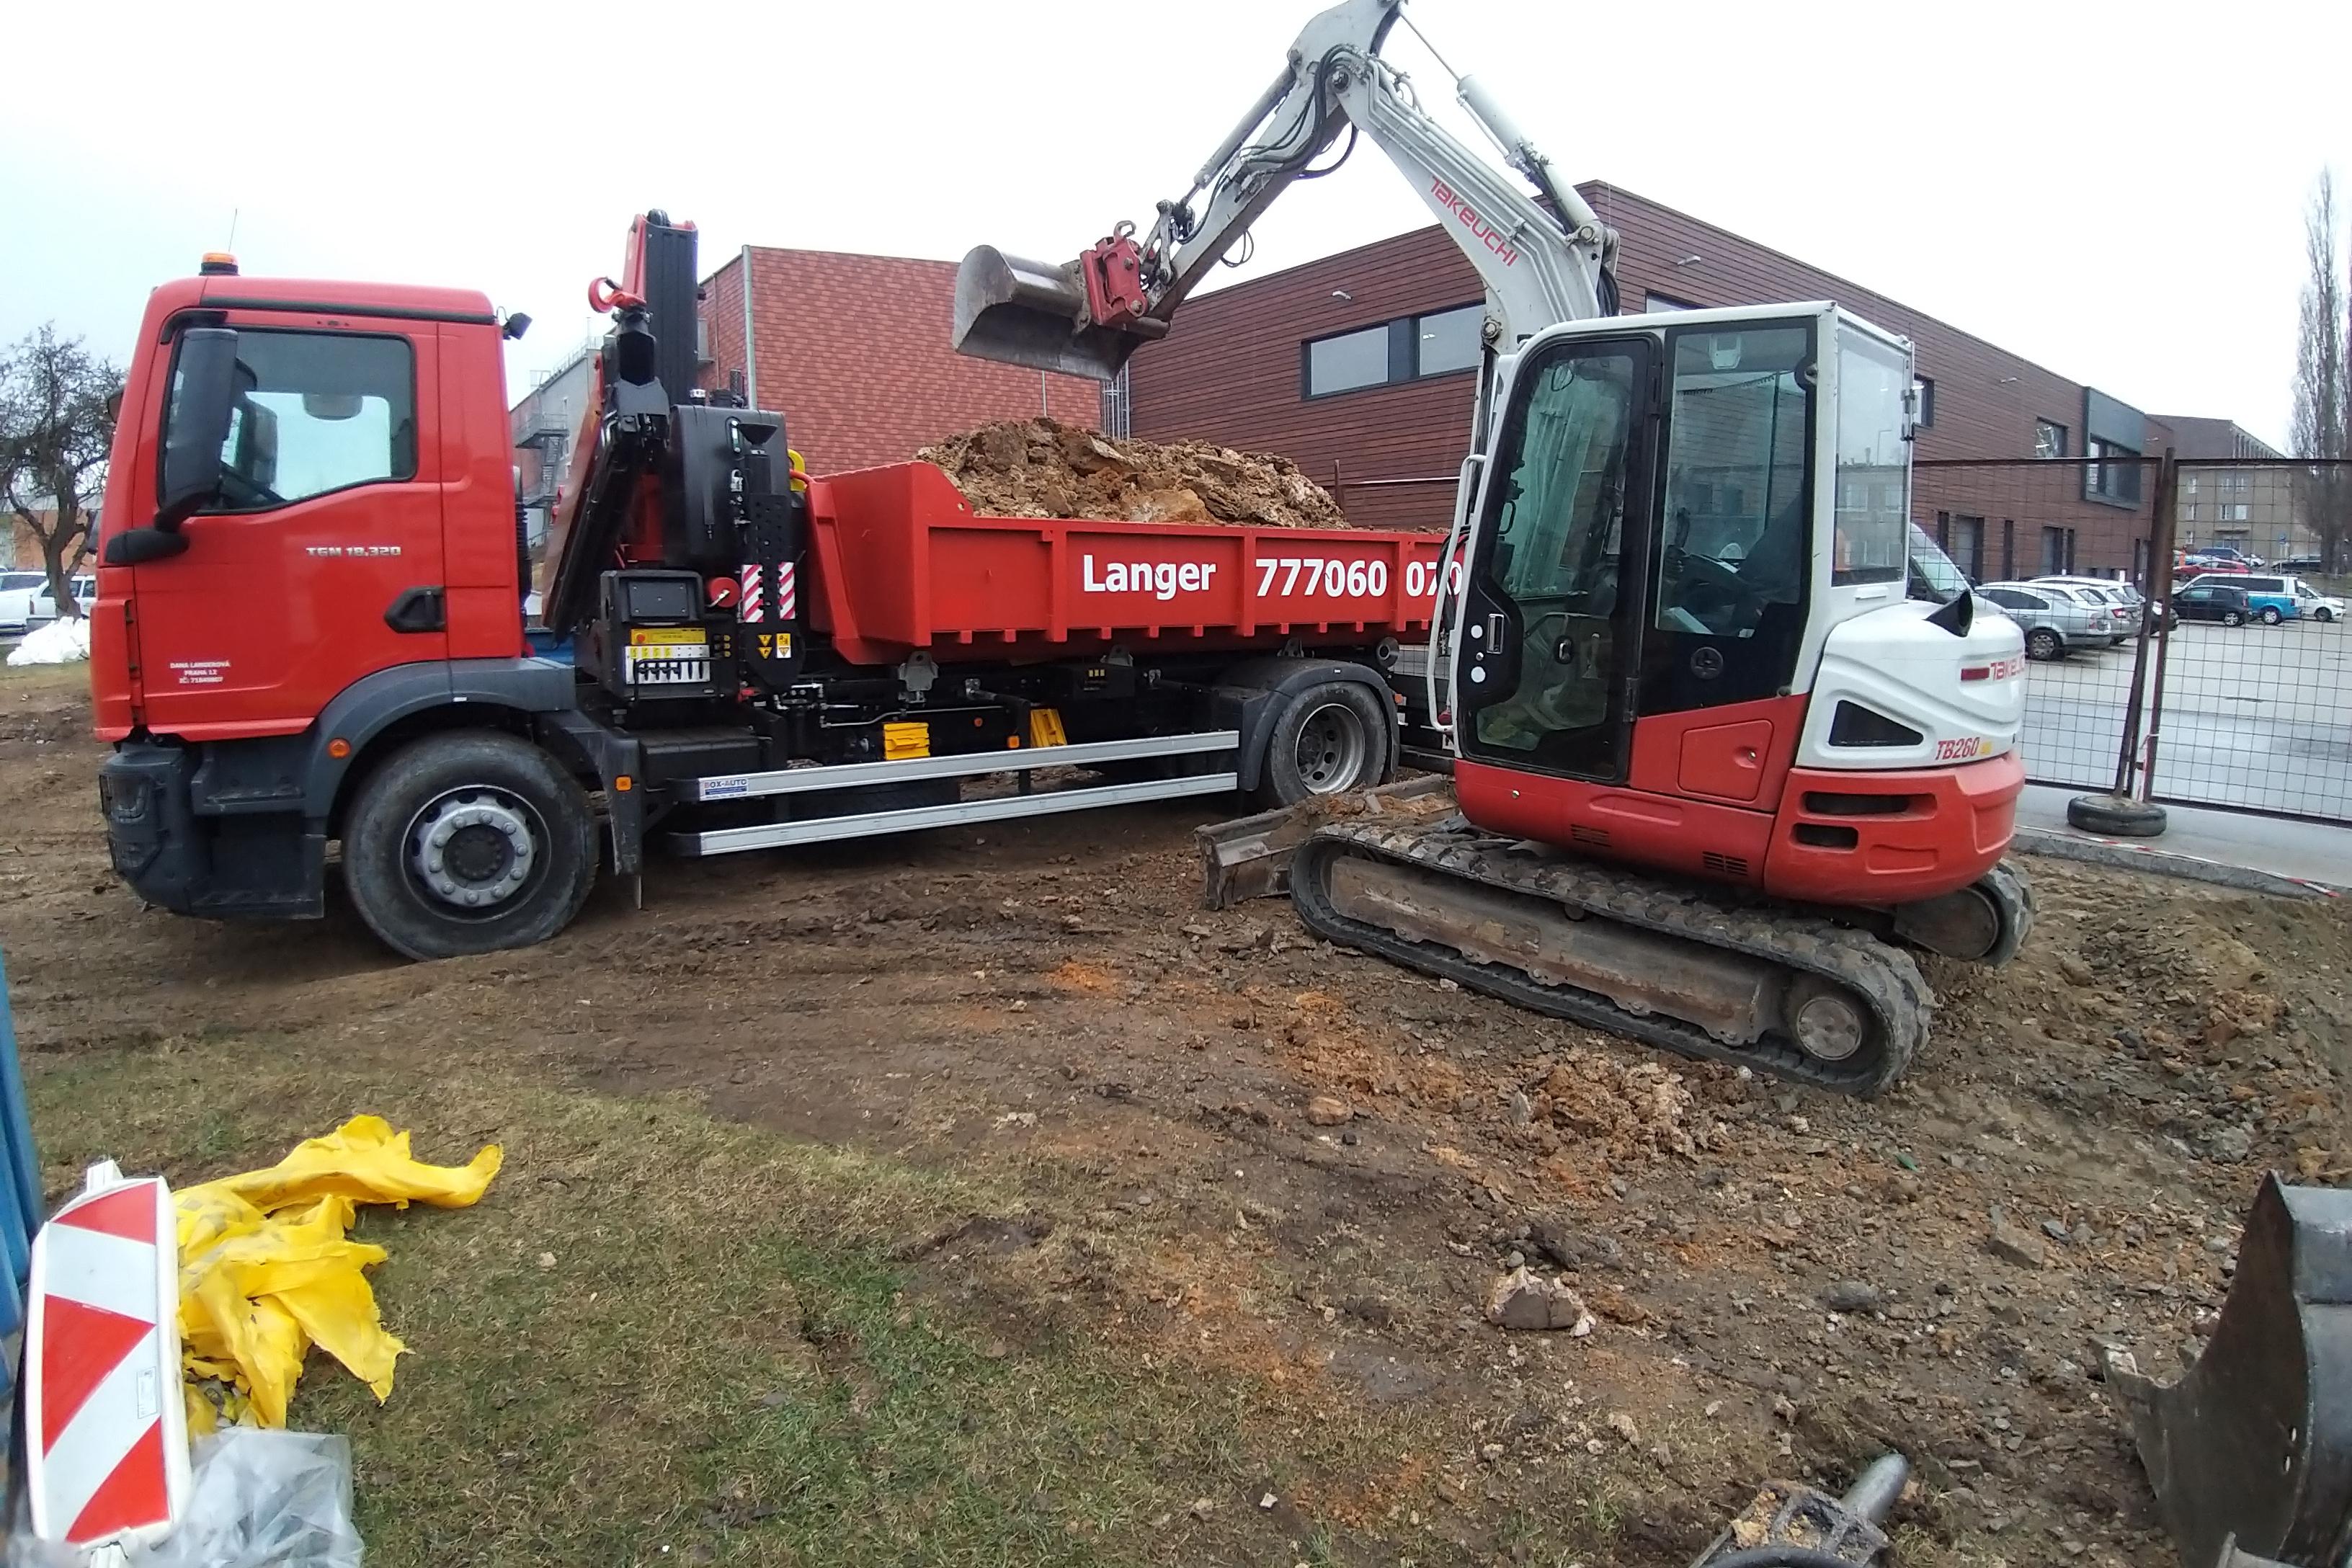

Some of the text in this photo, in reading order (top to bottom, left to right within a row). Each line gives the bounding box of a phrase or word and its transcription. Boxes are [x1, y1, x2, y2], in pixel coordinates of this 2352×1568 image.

[346, 546, 401, 556] 18.320
[1083, 554, 1217, 600] Langer
[1255, 558, 1388, 597] 777060
[1935, 736, 1980, 760] TB260
[704, 778, 747, 788] BOX-AUTO
